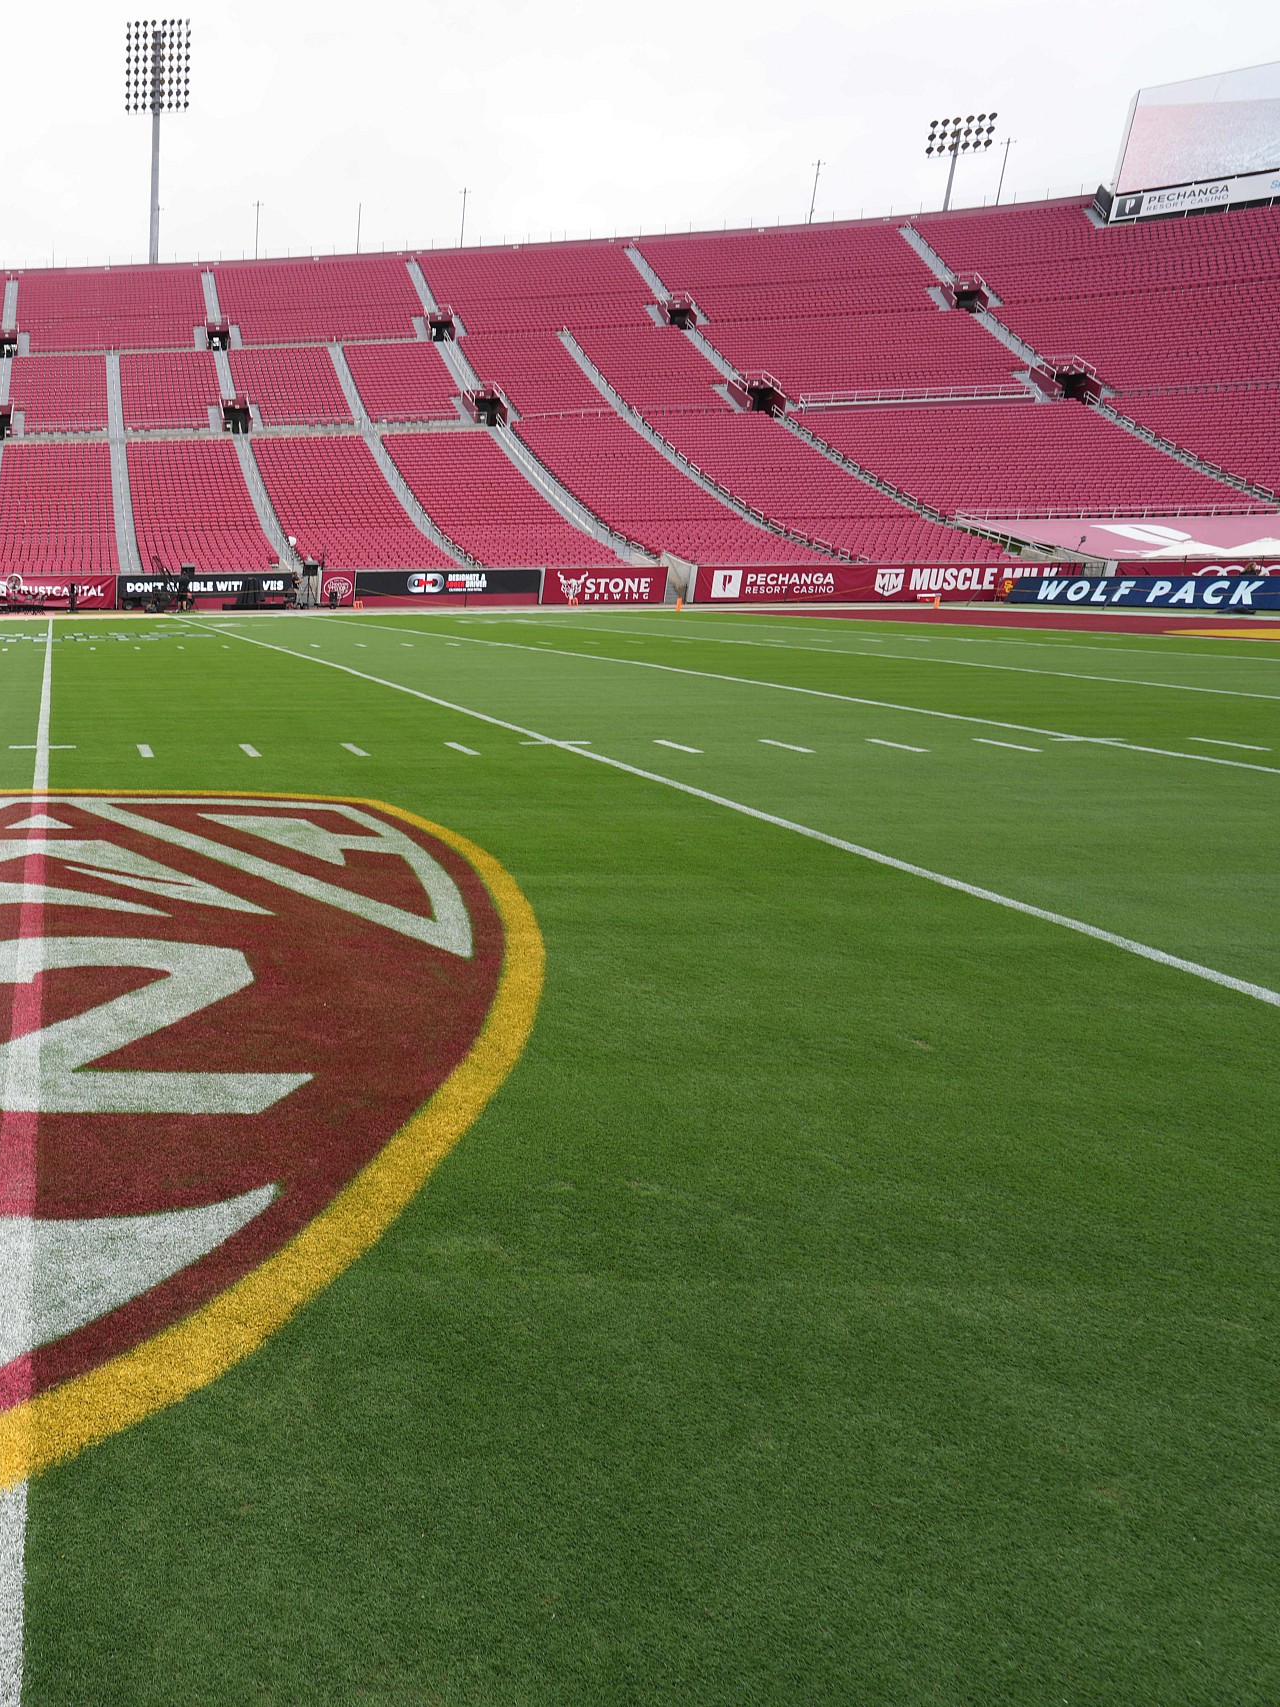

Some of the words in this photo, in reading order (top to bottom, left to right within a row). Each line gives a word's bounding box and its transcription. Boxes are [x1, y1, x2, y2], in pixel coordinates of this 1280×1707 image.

[1148, 184, 1230, 204] PECHANGA
[1145, 201, 1185, 212] RESORT
[1190, 193, 1229, 205] CASINO
[448, 573, 480, 581] DESIGNATE
[746, 572, 835, 585] PECHANGA
[909, 567, 998, 591] MUSCLE
[216, 580, 243, 592] WIT
[465, 580, 488, 588] DRIVER
[584, 577, 651, 593] STONE
[745, 585, 788, 594] RESORT
[793, 585, 835, 594] CASINO
[584, 593, 650, 601] BREWING
[1037, 580, 1137, 602] WOLF
[1145, 580, 1265, 605] PACK
